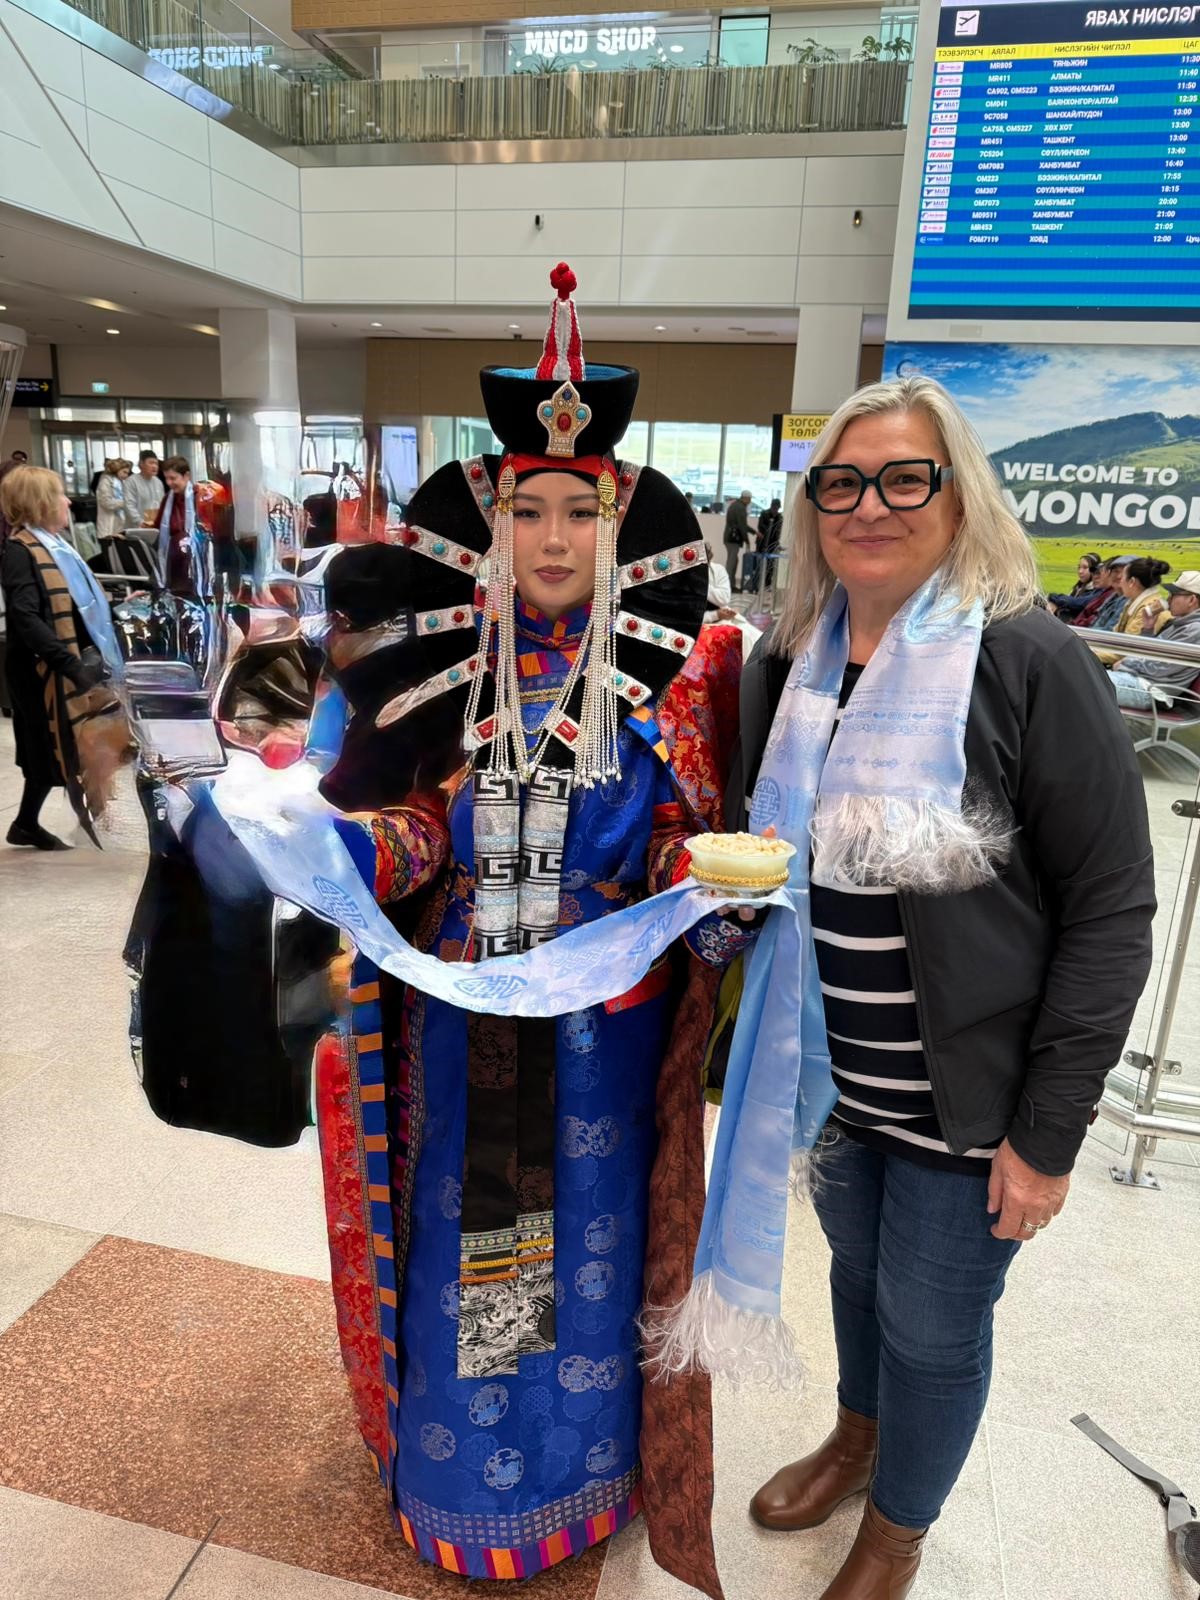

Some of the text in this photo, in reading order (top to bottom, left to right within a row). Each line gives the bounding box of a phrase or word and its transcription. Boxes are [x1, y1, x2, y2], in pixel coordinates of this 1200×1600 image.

[1085, 6, 1200, 26] ЯВАХ НИСЛЭГ
[525, 26, 656, 54] MNCD SHOP
[1183, 40, 1199, 48] ЦАГ
[1043, 136, 1075, 144] ТАШКЕНТ
[1003, 462, 1179, 486] WELCOME TO
